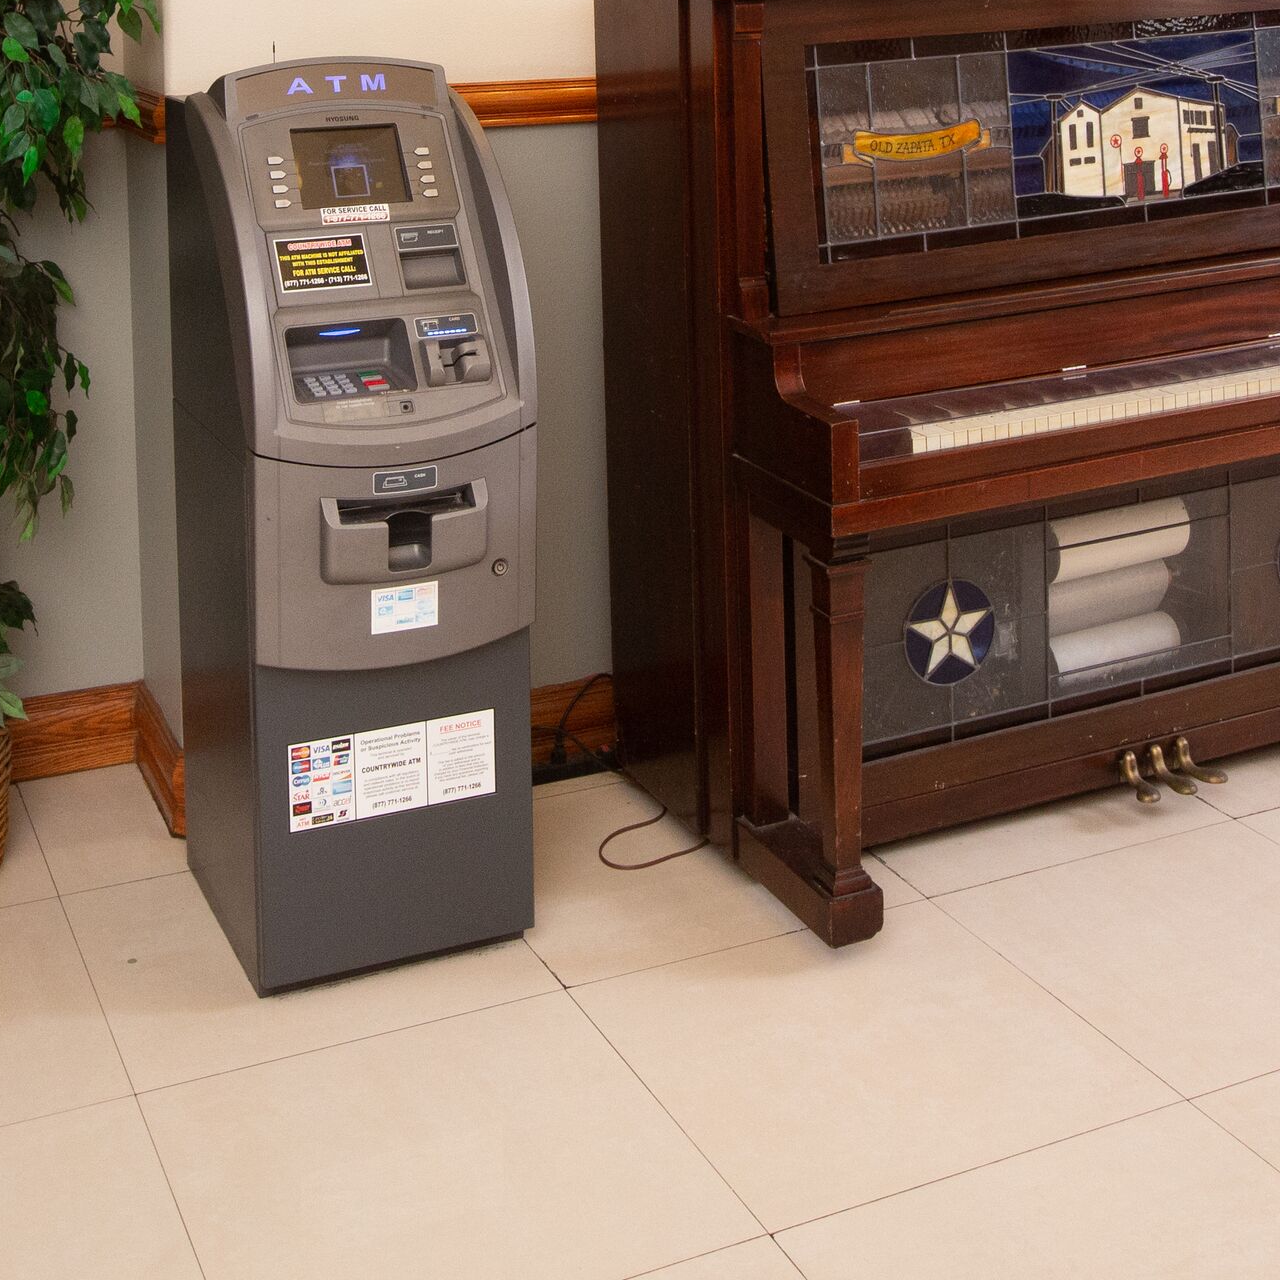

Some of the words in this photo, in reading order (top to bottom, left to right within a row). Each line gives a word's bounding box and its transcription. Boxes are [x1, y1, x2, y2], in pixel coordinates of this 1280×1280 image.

[287, 73, 386, 95] ATM
[870, 140, 893, 153] OLD
[940, 134, 955, 148] TX
[440, 724, 453, 732] FEE
[455, 720, 481, 729] NOTICE
[360, 736, 393, 746] Operational
[368, 742, 399, 751] Suspicious
[314, 745, 330, 754] VISA
[362, 760, 407, 773] COUNTRYWIDE
[408, 757, 421, 765] ATM
